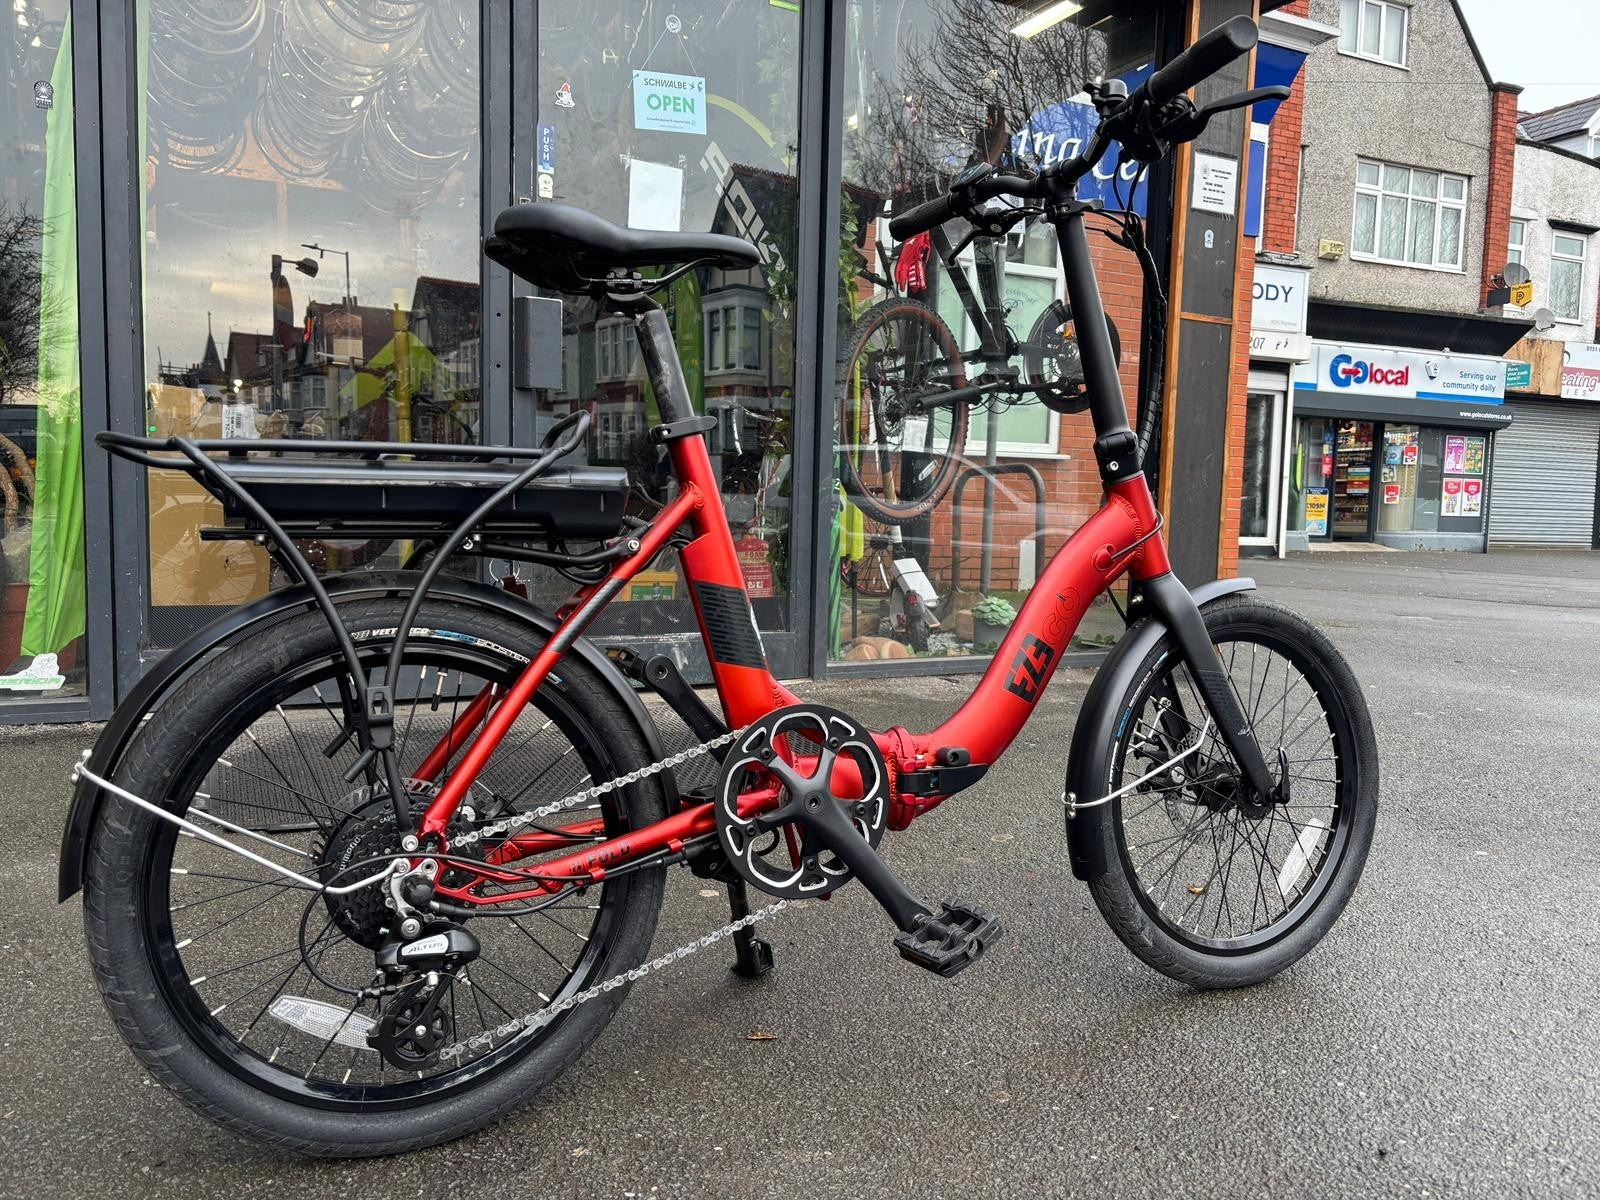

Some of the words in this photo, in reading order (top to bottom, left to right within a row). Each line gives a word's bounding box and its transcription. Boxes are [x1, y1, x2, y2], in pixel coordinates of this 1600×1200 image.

[644, 78, 687, 89] SCHWALBE
[646, 93, 695, 113] OPEN
[1459, 370, 1484, 381] Serving
[1442, 381, 1479, 391] community
[1480, 384, 1496, 393] daily
[1459, 410, 1512, 421] www.golocalstores.co.uk
[408, 942, 443, 953] ALTUS
